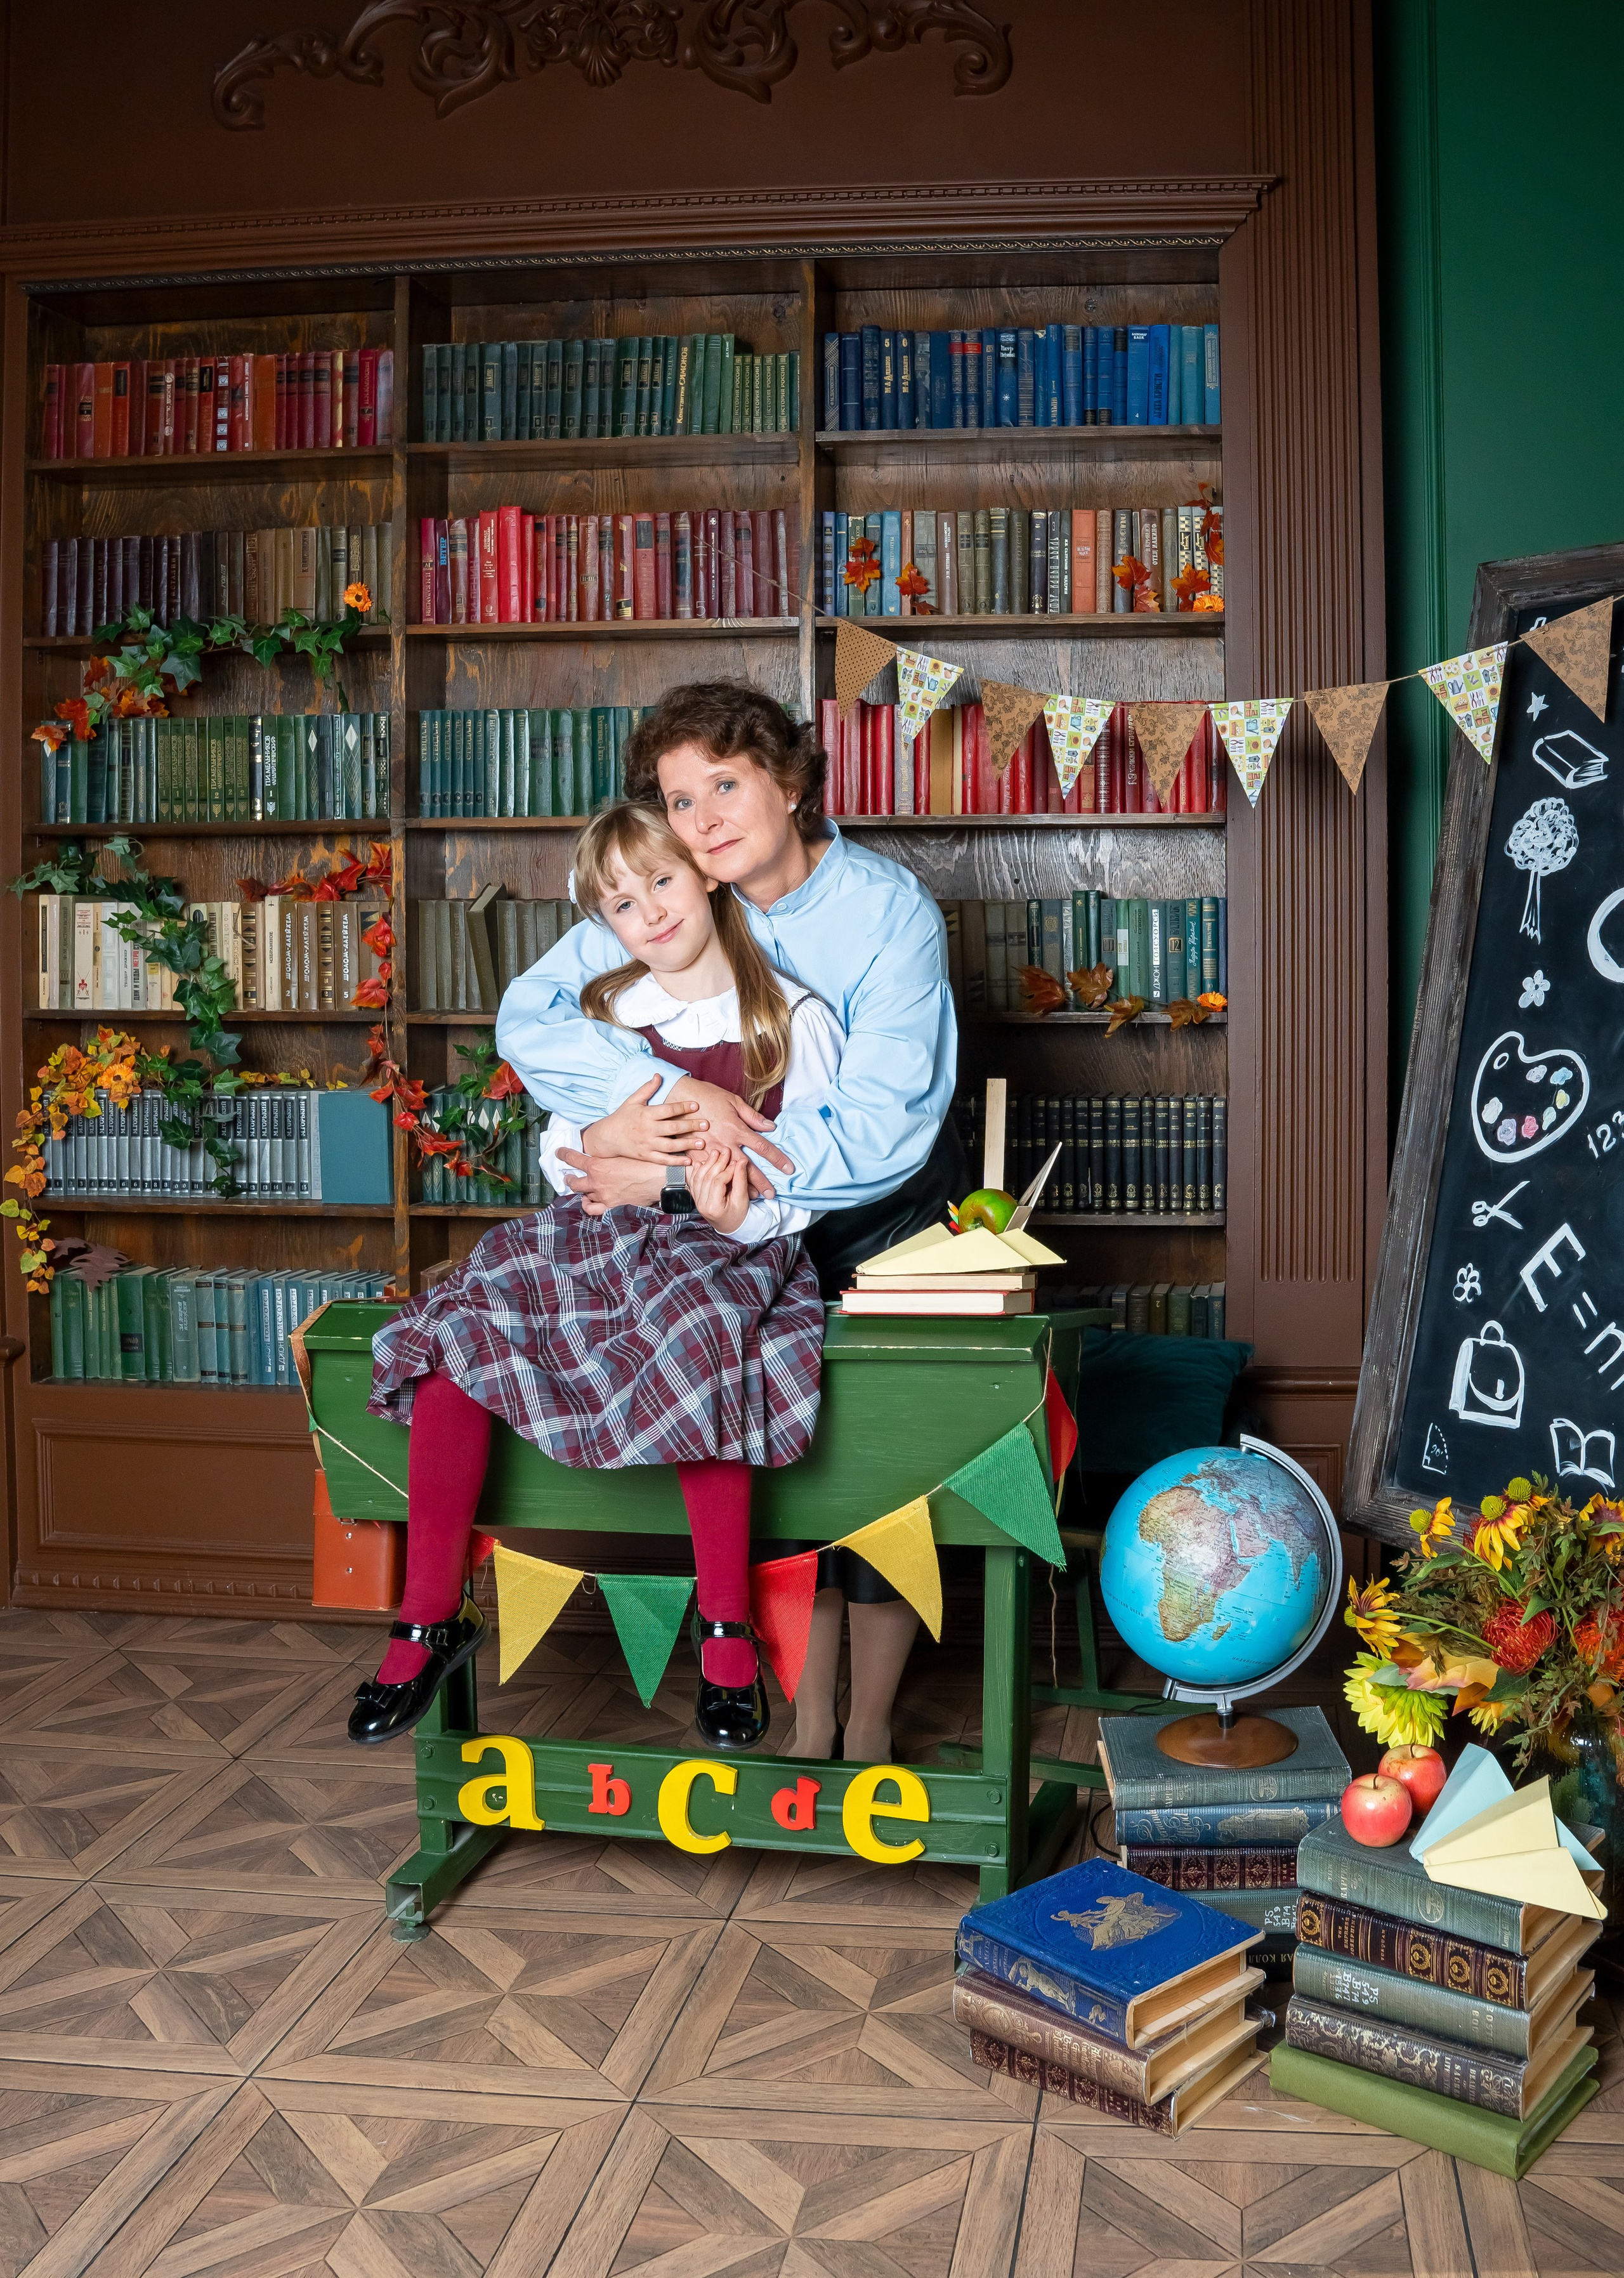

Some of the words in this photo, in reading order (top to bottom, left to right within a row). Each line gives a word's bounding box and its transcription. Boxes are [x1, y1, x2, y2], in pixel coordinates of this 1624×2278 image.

[678, 346, 688, 385] СИМОНОВ
[1153, 373, 1163, 398] КРИСТИ
[676, 386, 686, 424] Константин
[1153, 399, 1163, 419] АГАТА
[696, 600, 706, 616] 5
[1152, 966, 1161, 990] ДЖОН
[264, 1342, 272, 1366] ДЖОН
[458, 1735, 545, 1830] a
[587, 1763, 632, 1816] b
[658, 1758, 738, 1854] c
[771, 1776, 822, 1831] d
[842, 1764, 931, 1864] e
[1264, 1909, 1274, 1925] PS
[1342, 1972, 1351, 2001] B747
[1351, 1976, 1361, 2003] B74
[1369, 1986, 1379, 2005] PS
